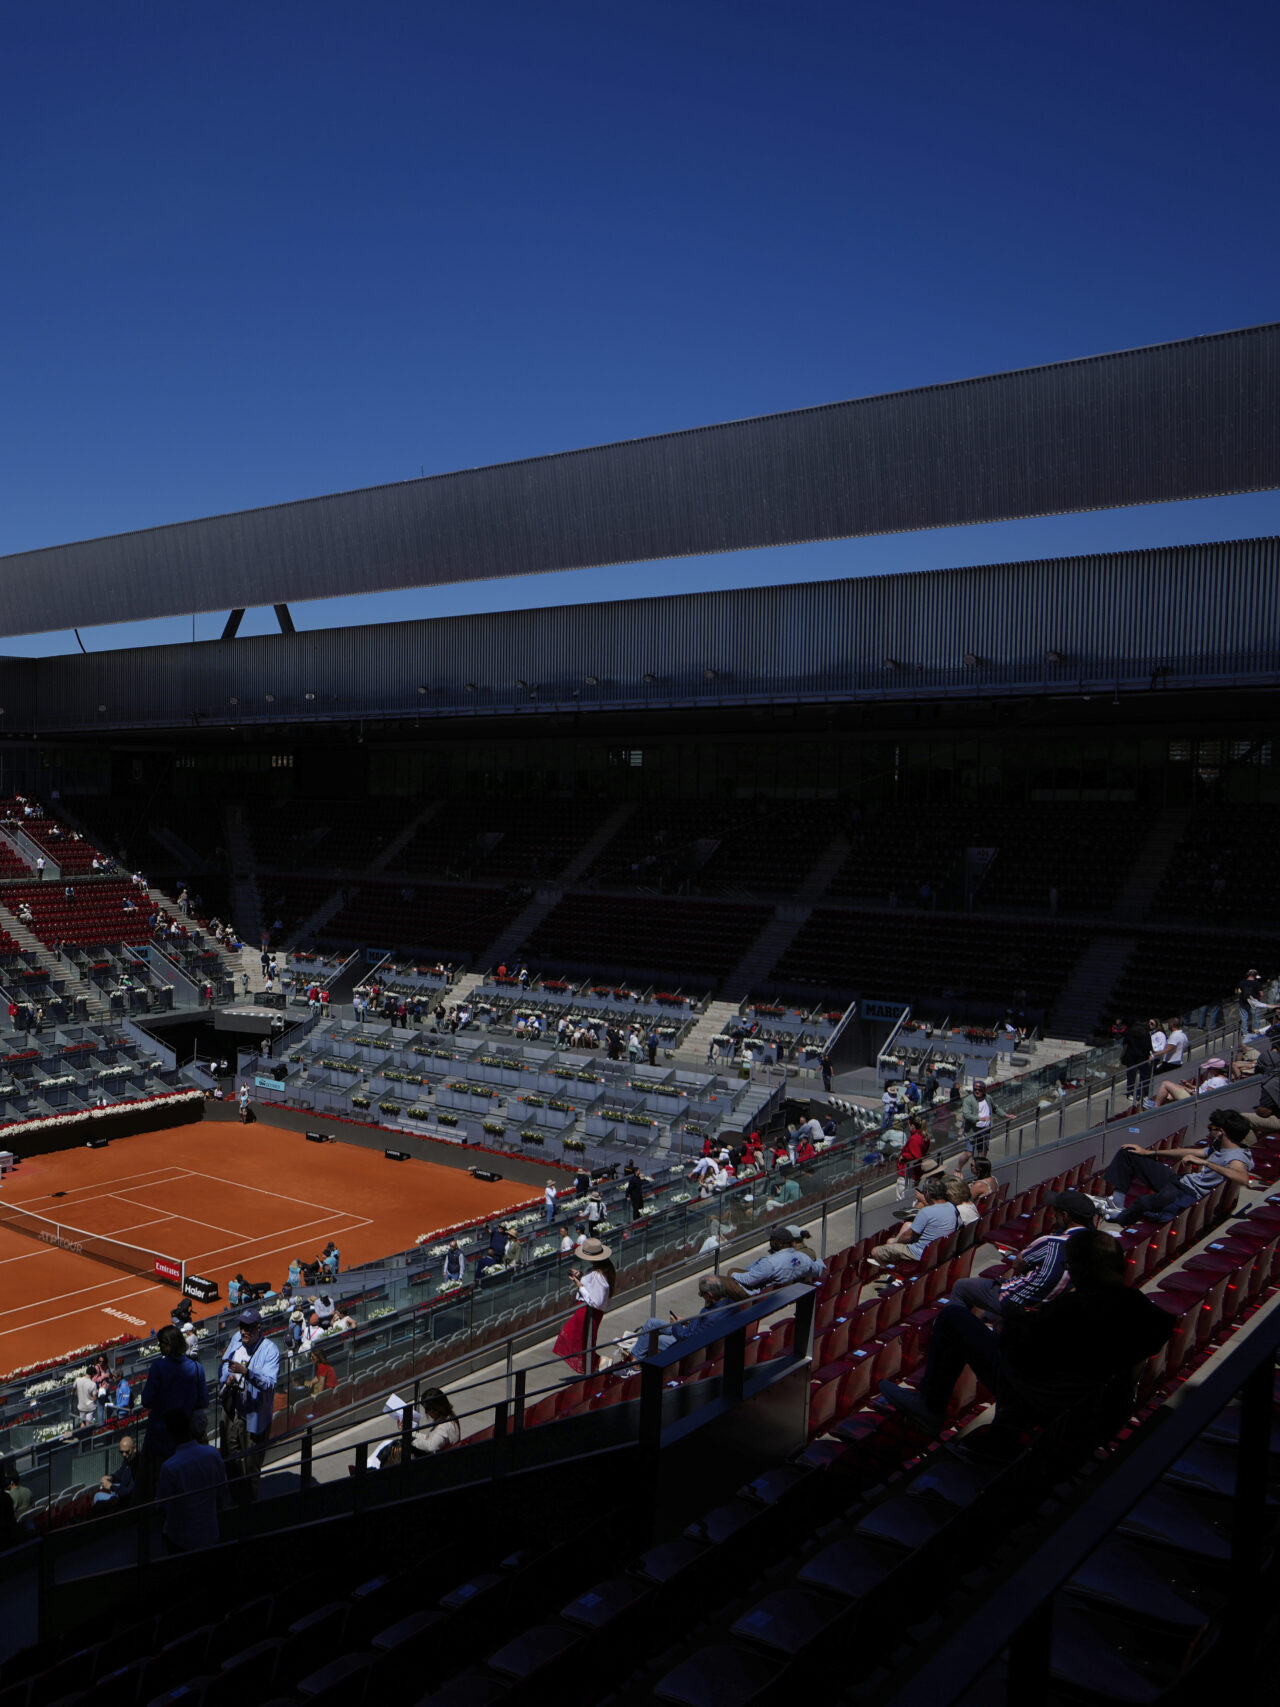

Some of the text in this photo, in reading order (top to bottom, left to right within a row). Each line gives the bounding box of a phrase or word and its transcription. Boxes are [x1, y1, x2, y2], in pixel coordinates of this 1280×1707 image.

[155, 1261, 180, 1278] Emirates
[184, 1283, 205, 1299] Haier
[100, 1307, 147, 1327] MADRID
